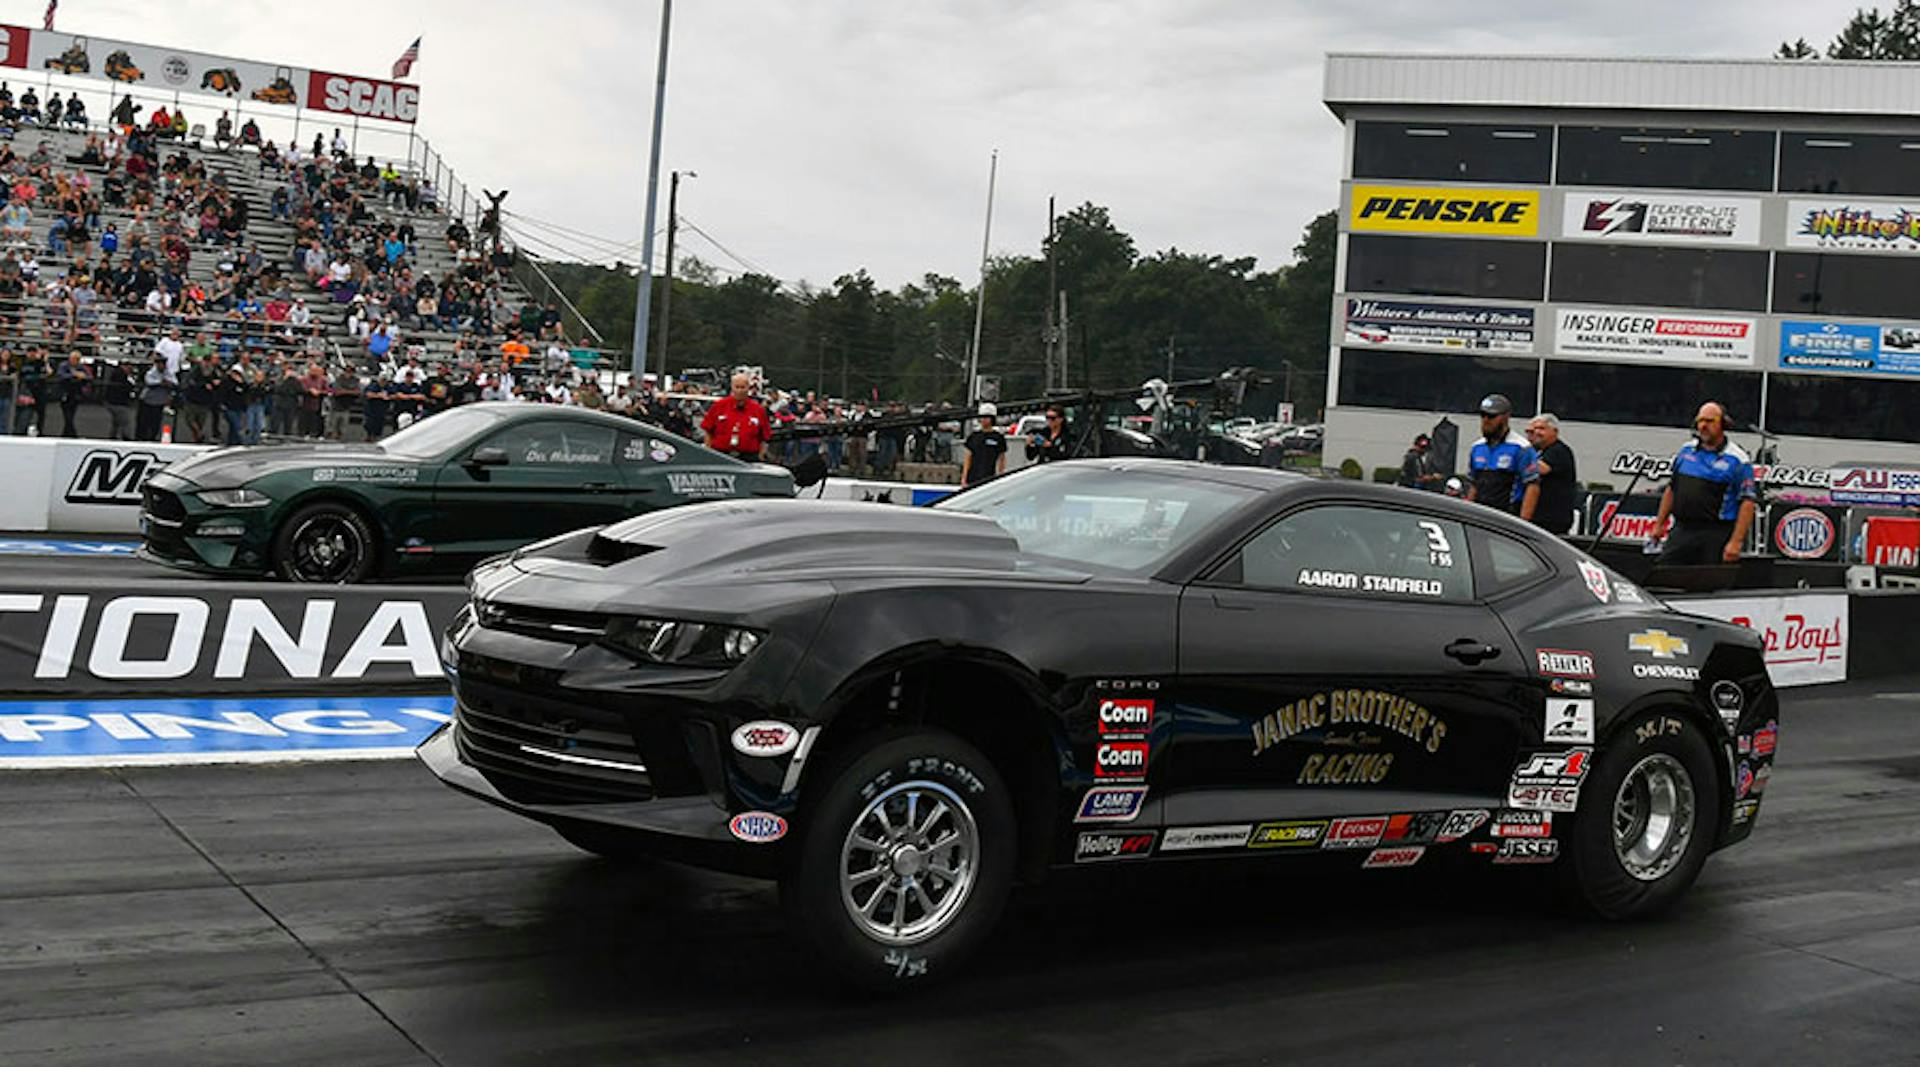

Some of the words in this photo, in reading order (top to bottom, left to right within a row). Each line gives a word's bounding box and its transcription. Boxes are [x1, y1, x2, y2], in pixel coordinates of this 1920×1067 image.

[324, 77, 417, 119] SCAG
[1359, 196, 1531, 224] PENSKE
[1648, 216, 1738, 231] BATTERIES
[1352, 299, 1411, 320] Winters
[1475, 313, 1487, 324] &
[1563, 314, 1656, 335] INSINGER
[1659, 321, 1746, 337] PERFORMANCE
[1606, 336, 1630, 345] FUEL
[1638, 338, 1698, 349] INDUSTRIAL
[1790, 333, 1873, 352] FINKE
[667, 473, 736, 495] VARSITY
[1418, 519, 1451, 552] 3
[1784, 517, 1826, 551] NHRA
[1298, 569, 1358, 589] AARON
[1361, 574, 1442, 596] STANFIELD
[1784, 615, 1842, 664] Boys
[1632, 664, 1701, 681] CHEVROLET
[1096, 680, 1160, 690] COPO
[1100, 701, 1148, 723] Coan
[1252, 692, 1327, 757] JANAC
[1329, 689, 1448, 753] BROTHER'S
[1635, 716, 1683, 744] M/T
[1098, 744, 1143, 766] Coan
[1517, 752, 1586, 777] JR1
[907, 757, 986, 794] FRONT
[1296, 752, 1395, 785] RACING
[1092, 793, 1133, 809] LAMB
[739, 816, 781, 837] NHRA
[1498, 810, 1542, 824] LINCOLN
[1502, 823, 1544, 836] WELDERS
[1079, 835, 1124, 856] Holley
